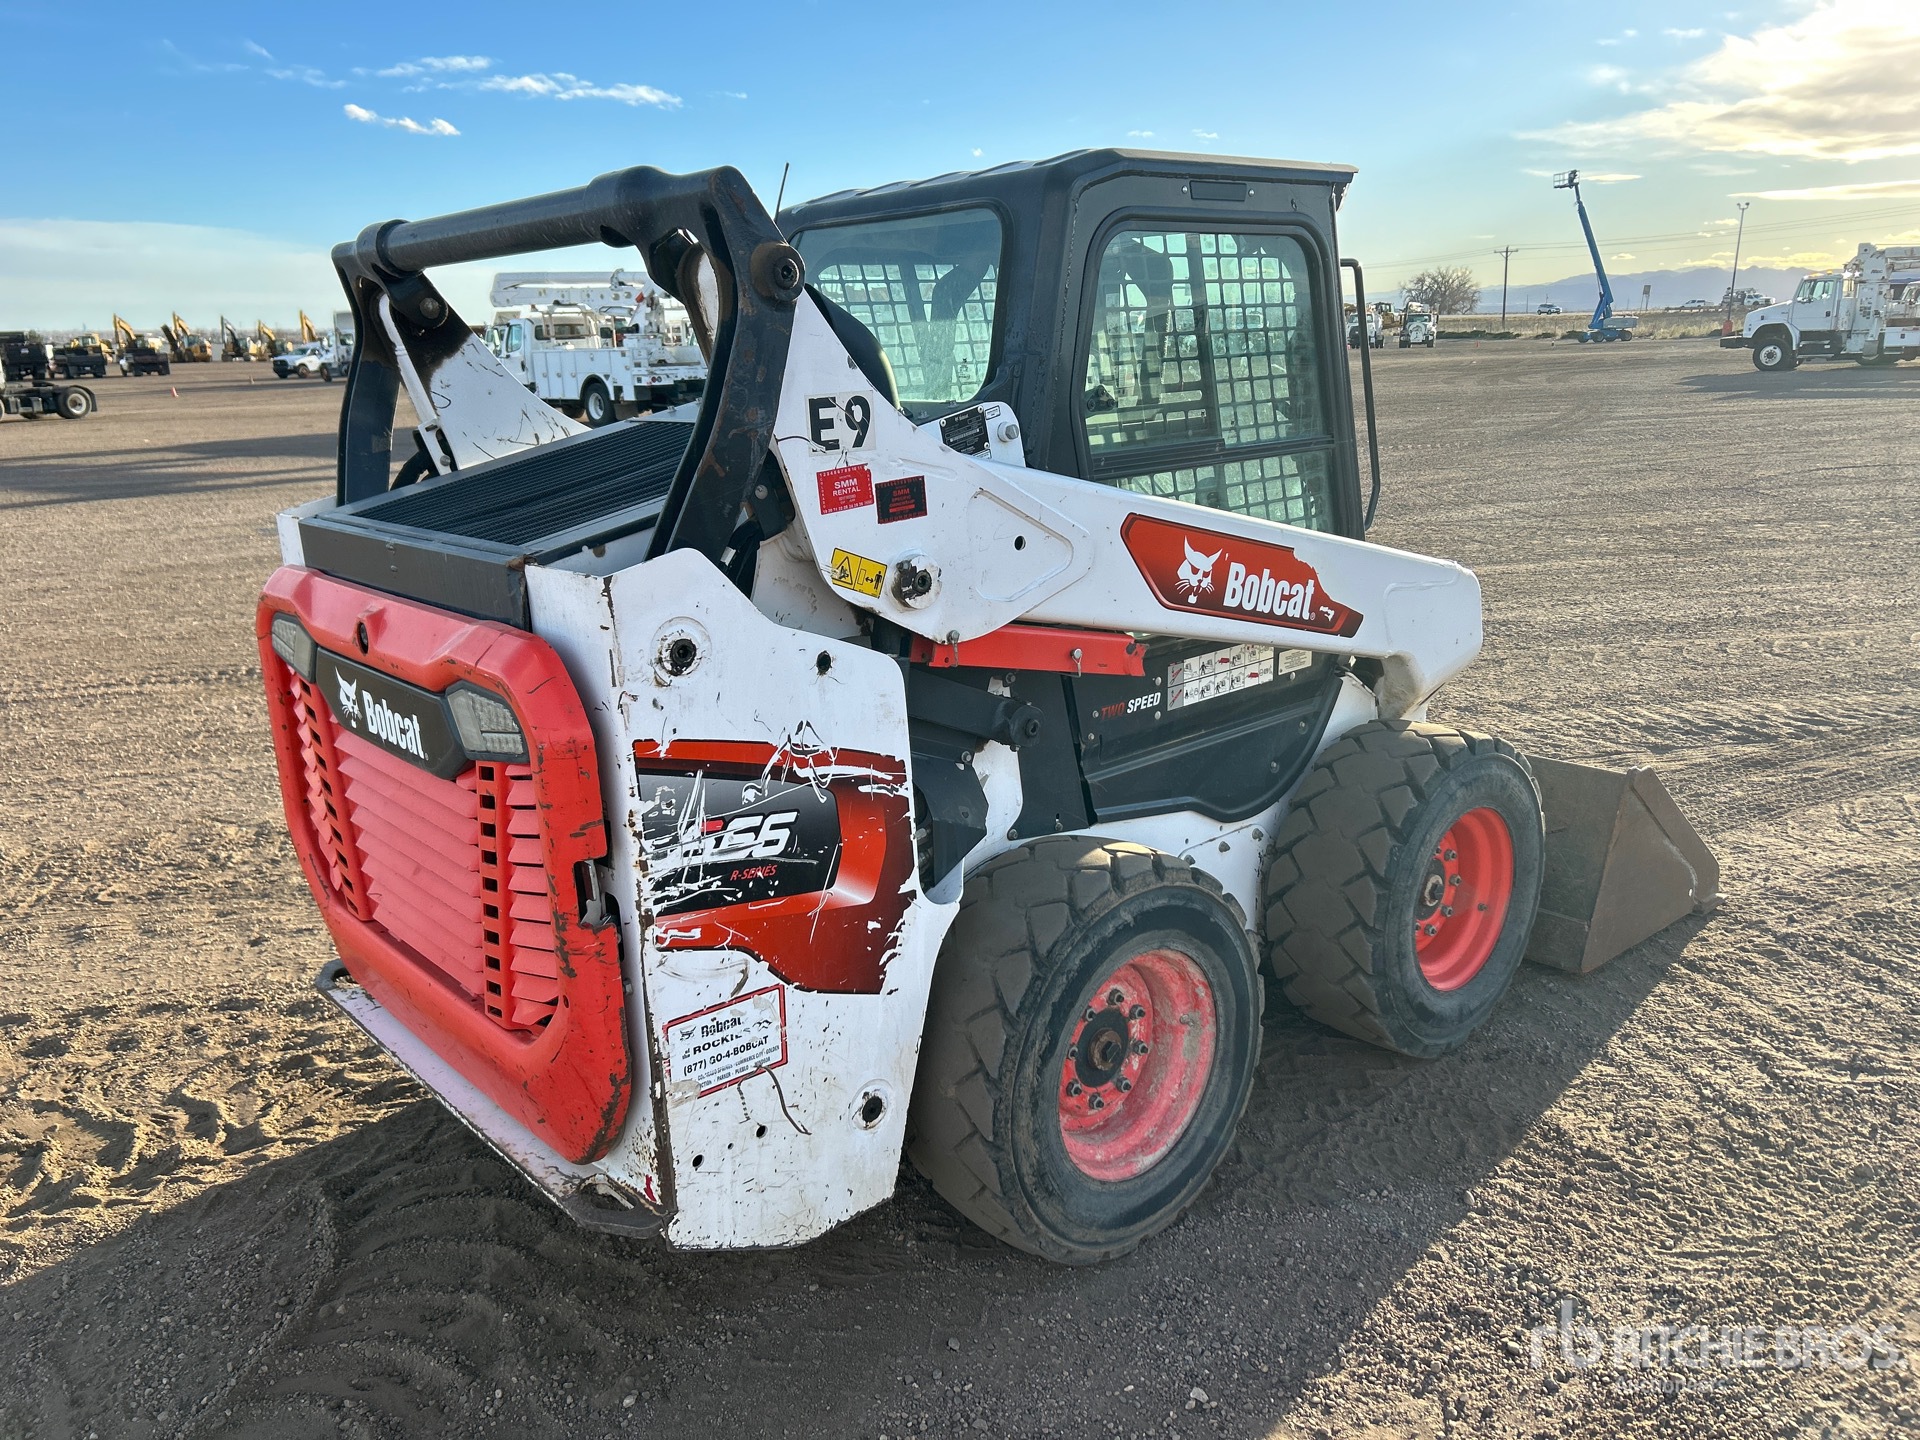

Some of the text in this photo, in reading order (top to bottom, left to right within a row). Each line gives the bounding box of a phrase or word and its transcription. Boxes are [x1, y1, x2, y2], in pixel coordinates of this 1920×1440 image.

[809, 395, 871, 452] E9
[832, 486, 861, 497] RENTAL
[834, 478, 858, 489] SMM
[892, 488, 910, 497] SMM
[1223, 561, 1316, 621] Bobcat
[1101, 691, 1162, 720] TWO SPEED
[362, 689, 425, 760] Bobcat
[730, 863, 778, 882] R-SERIES
[683, 1035, 769, 1076] (877) GO-4-BOBCAT
